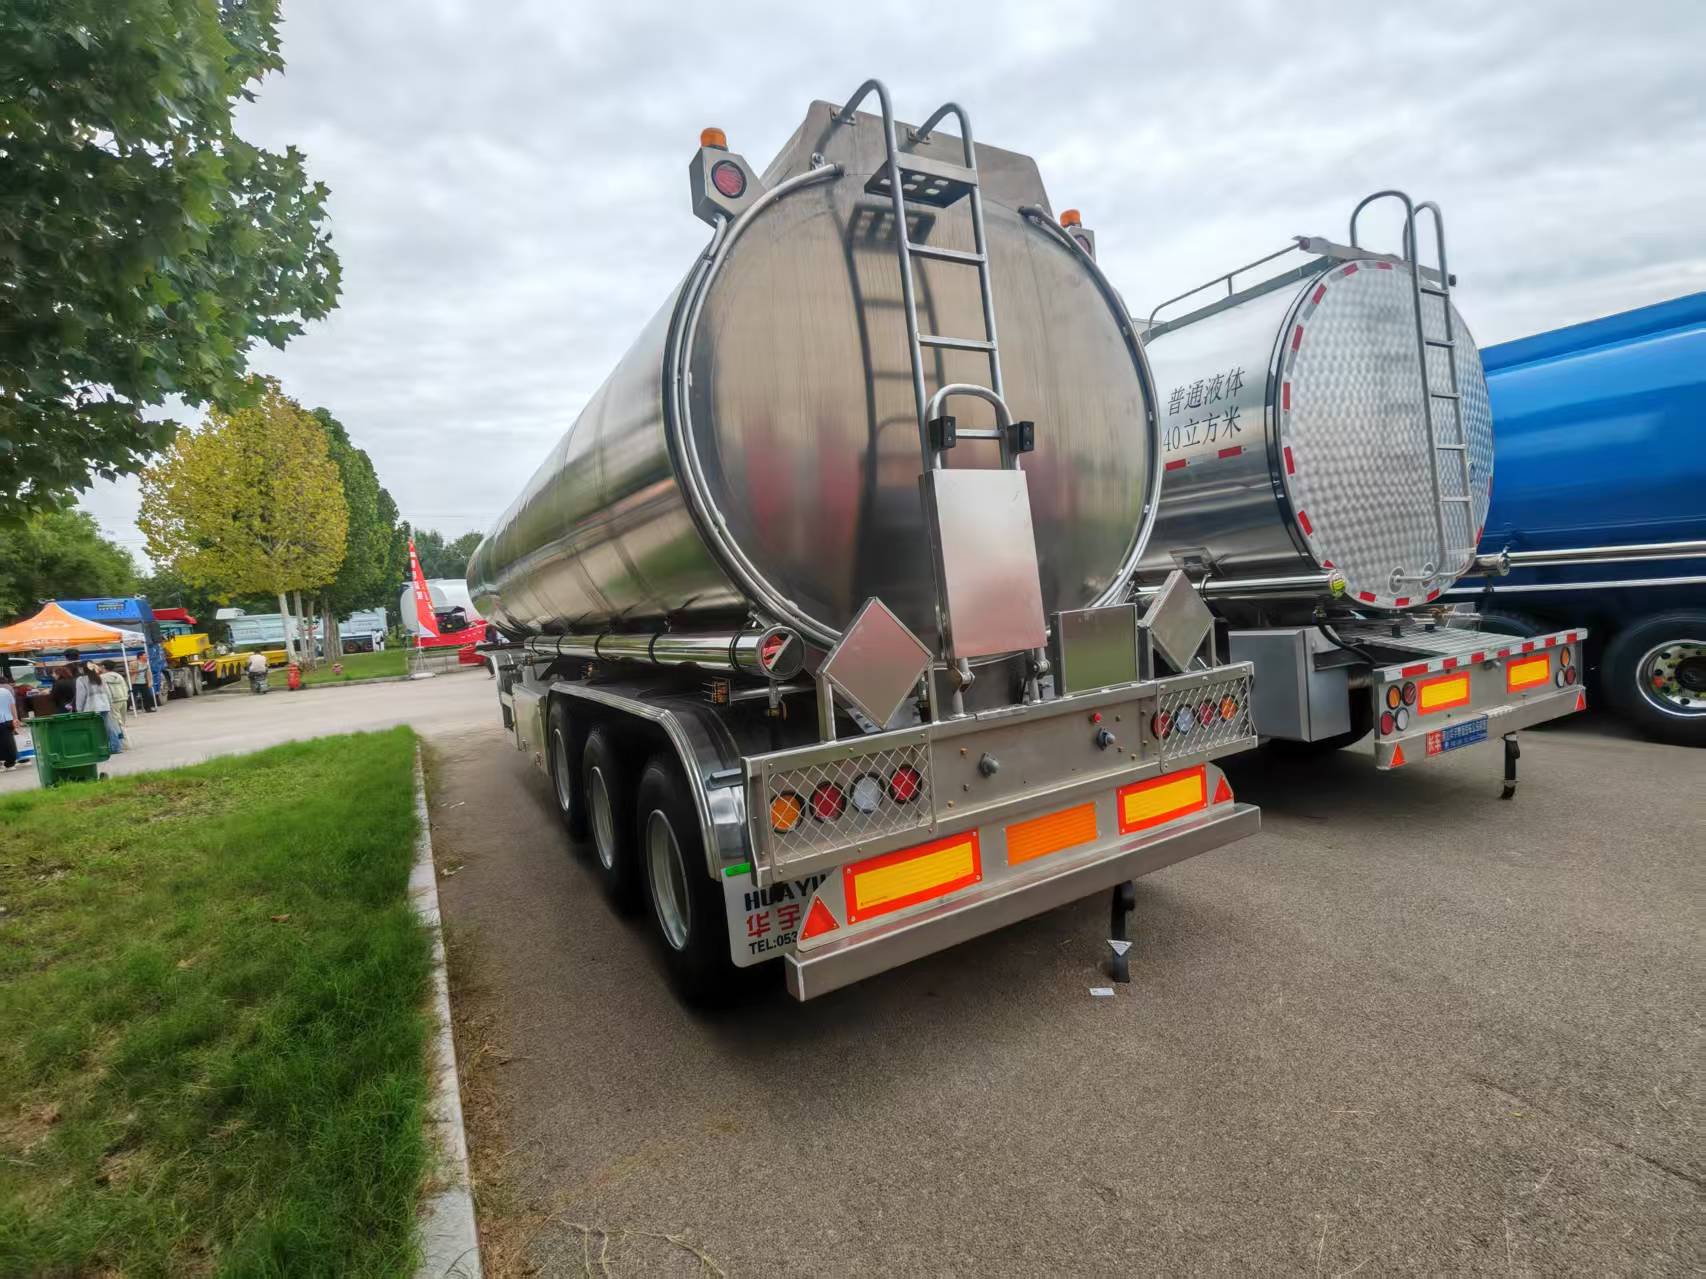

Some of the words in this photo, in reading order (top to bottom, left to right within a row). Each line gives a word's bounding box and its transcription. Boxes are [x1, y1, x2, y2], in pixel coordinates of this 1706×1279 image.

[1168, 367, 1245, 416] 普通液体
[1163, 405, 1242, 452] 40立方米
[746, 904, 801, 937] 华宇
